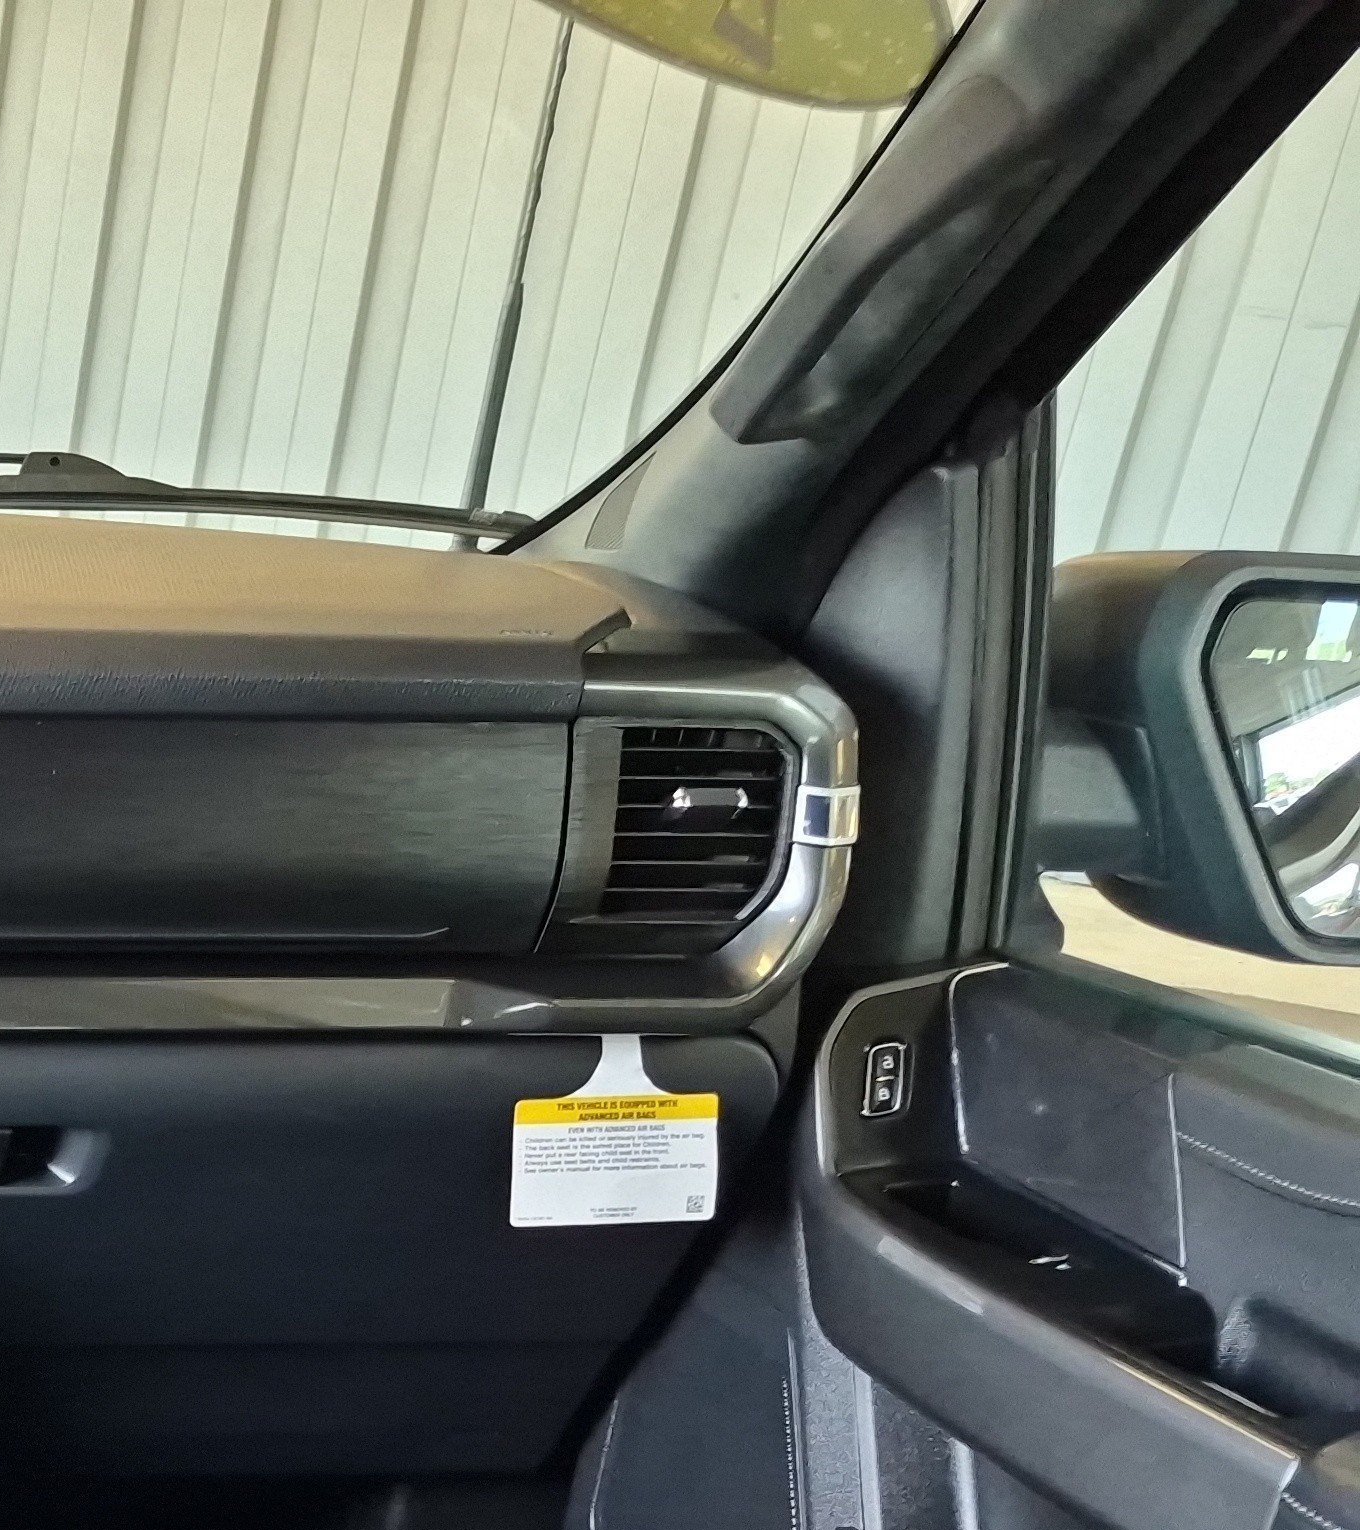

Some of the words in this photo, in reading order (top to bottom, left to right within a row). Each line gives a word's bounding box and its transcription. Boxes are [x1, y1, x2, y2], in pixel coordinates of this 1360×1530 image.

[557, 1103, 575, 1111] THIS
[577, 1102, 608, 1110] VEHICLE
[610, 1101, 618, 1109] IS
[578, 1112, 619, 1121] ADVANCED
[637, 1111, 656, 1119] BAGS
